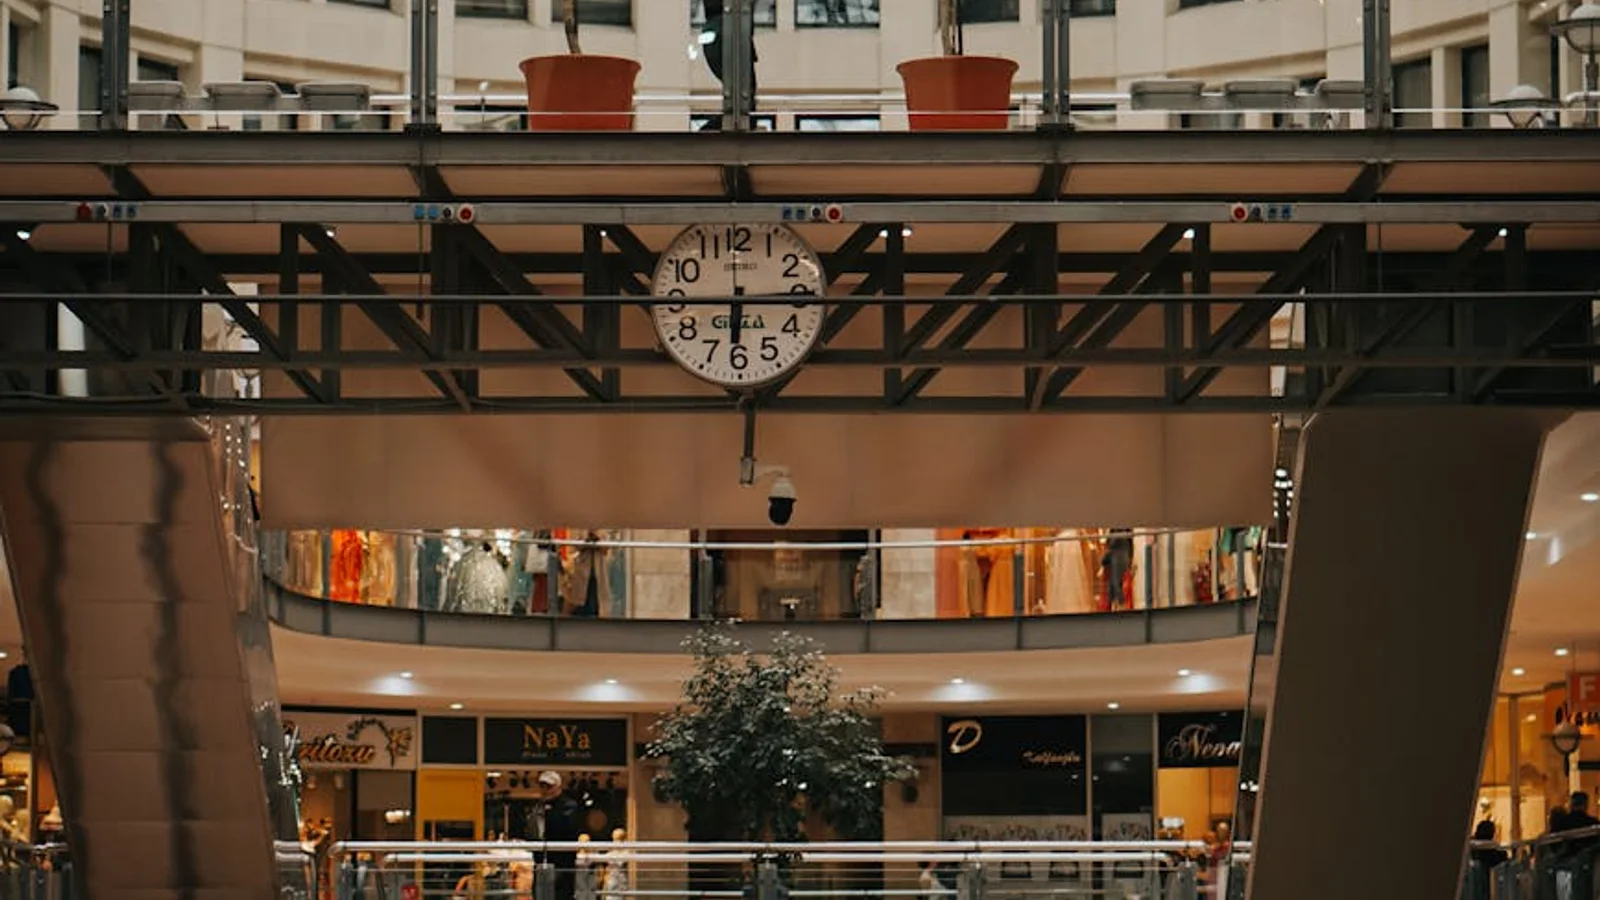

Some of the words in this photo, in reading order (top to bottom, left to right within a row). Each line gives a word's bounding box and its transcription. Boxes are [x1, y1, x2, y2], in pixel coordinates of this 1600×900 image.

[700, 235, 719, 259] 11
[726, 228, 752, 252] 12
[766, 234, 771, 258] 1
[675, 258, 700, 283] 10
[782, 254, 799, 278] 2
[679, 316, 697, 341] 8
[781, 314, 801, 337] 4
[703, 340, 720, 363] 7
[730, 345, 748, 370] 6
[760, 337, 778, 361] 5
[523, 723, 592, 750] NaYa
[946, 719, 983, 755] D
